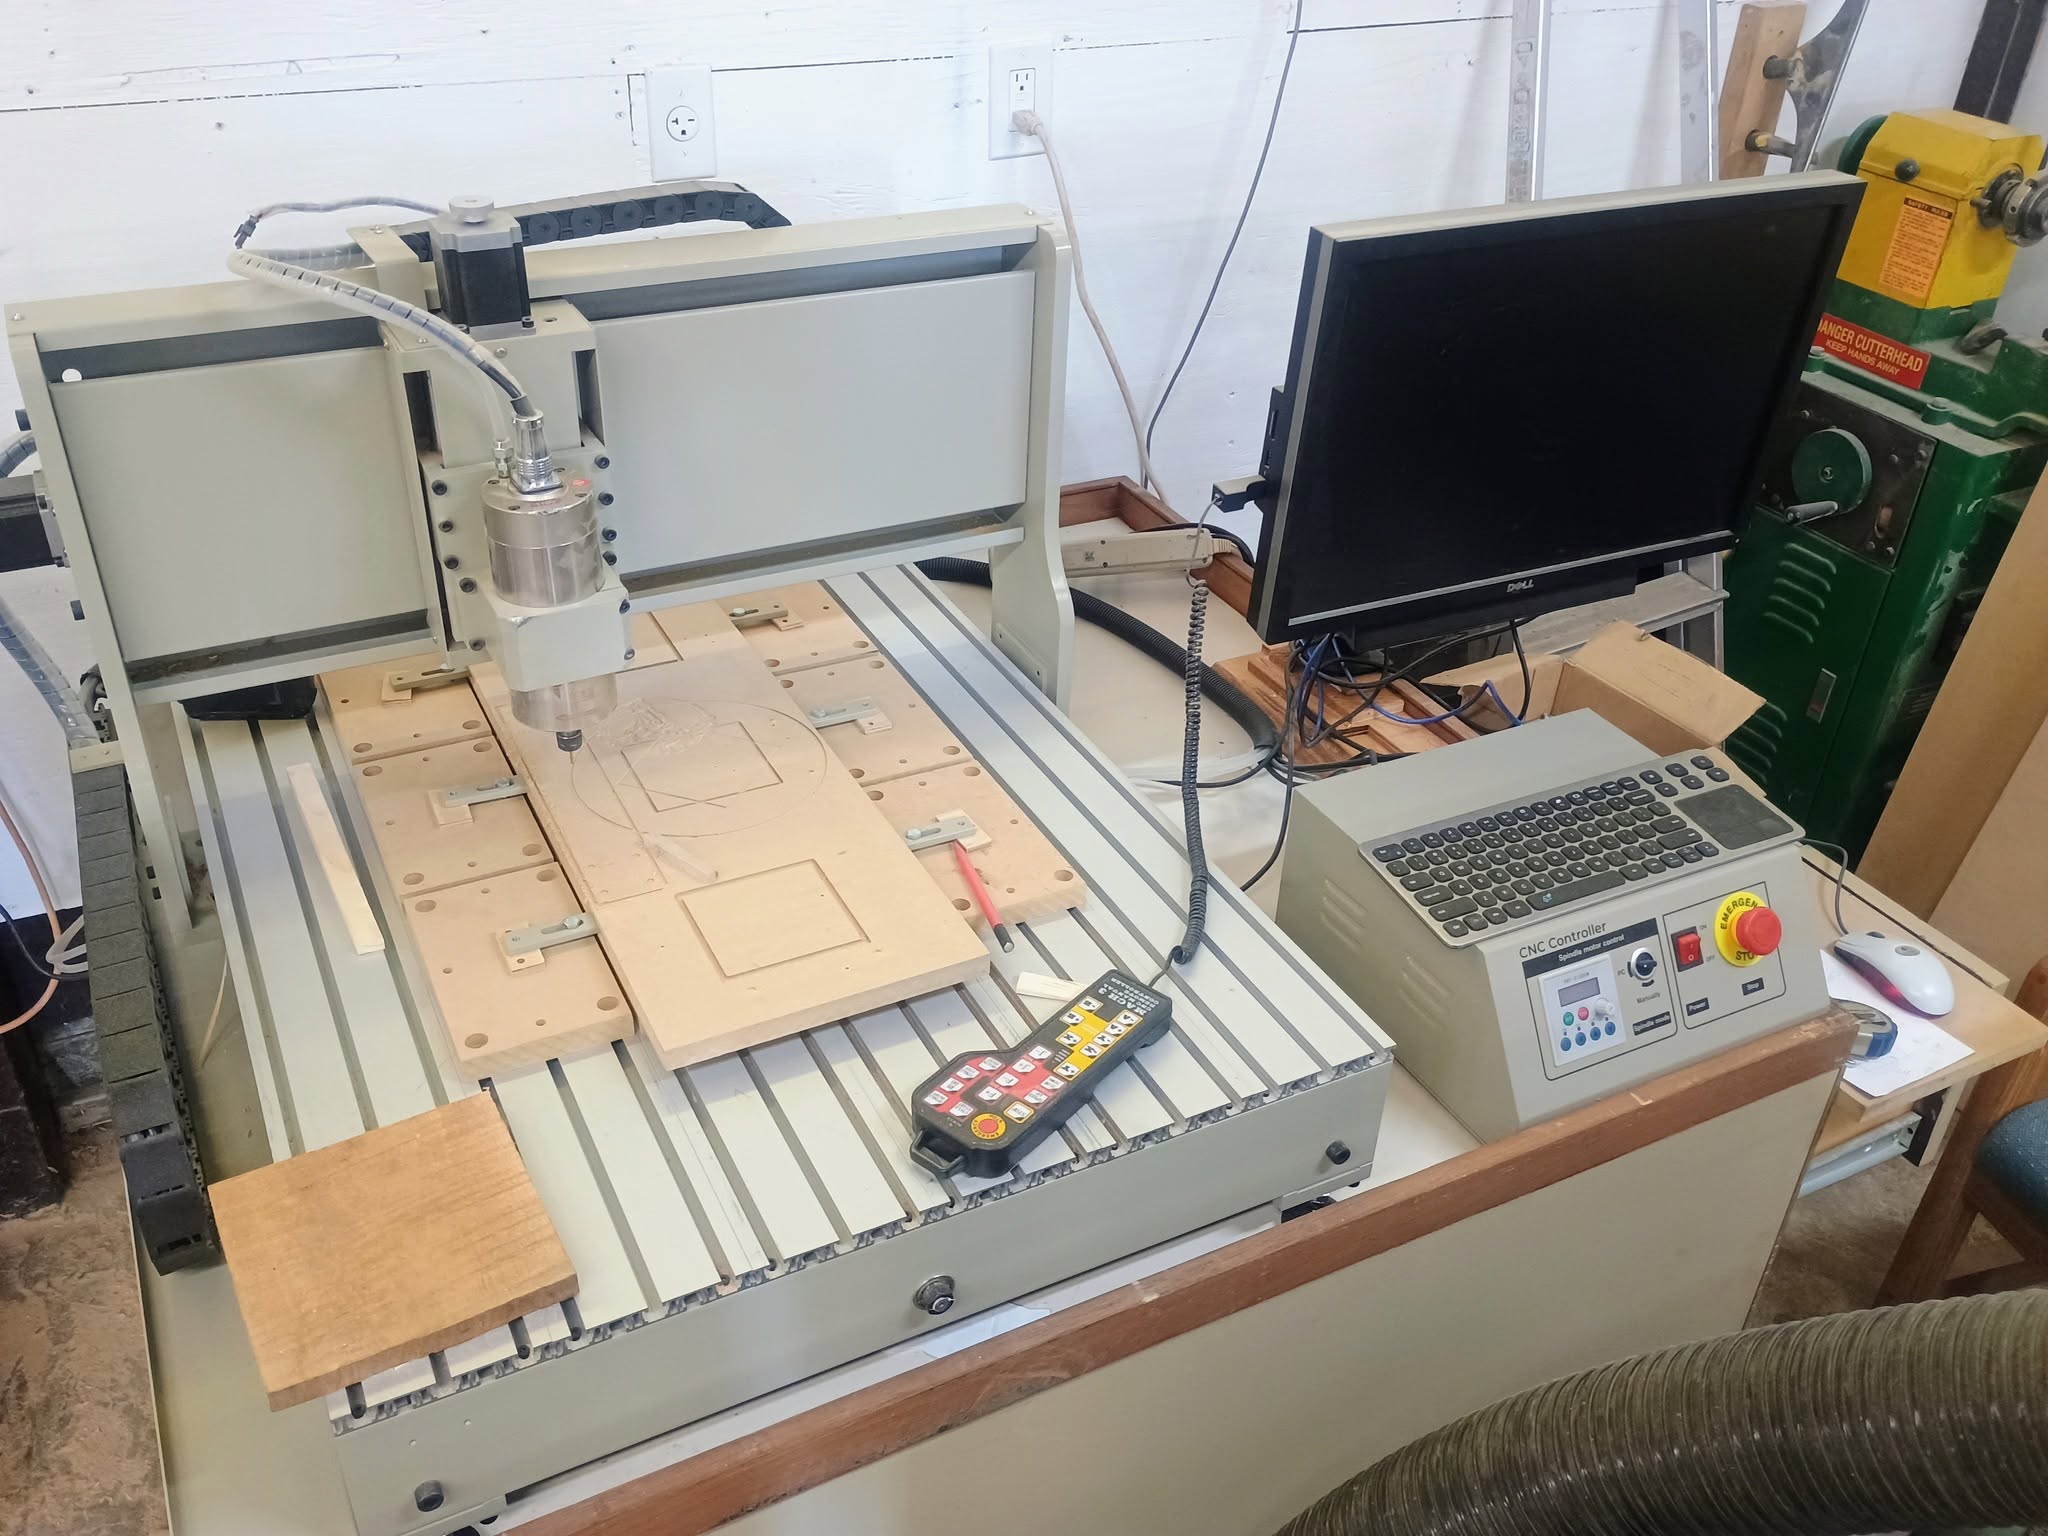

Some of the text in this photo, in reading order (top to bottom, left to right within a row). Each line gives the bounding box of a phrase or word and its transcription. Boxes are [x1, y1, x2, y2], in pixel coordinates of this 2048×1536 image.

[1825, 338, 1900, 376] KEEP HANDS AWAY
[1855, 333, 1923, 372] CUTTERHEAD
[1506, 579, 1534, 593] DELL
[1720, 897, 1758, 930] EMERGEN
[1519, 923, 1606, 958] CNC Controller
[1558, 934, 1624, 962] Spindle motor control
[1735, 950, 1757, 961] STO
